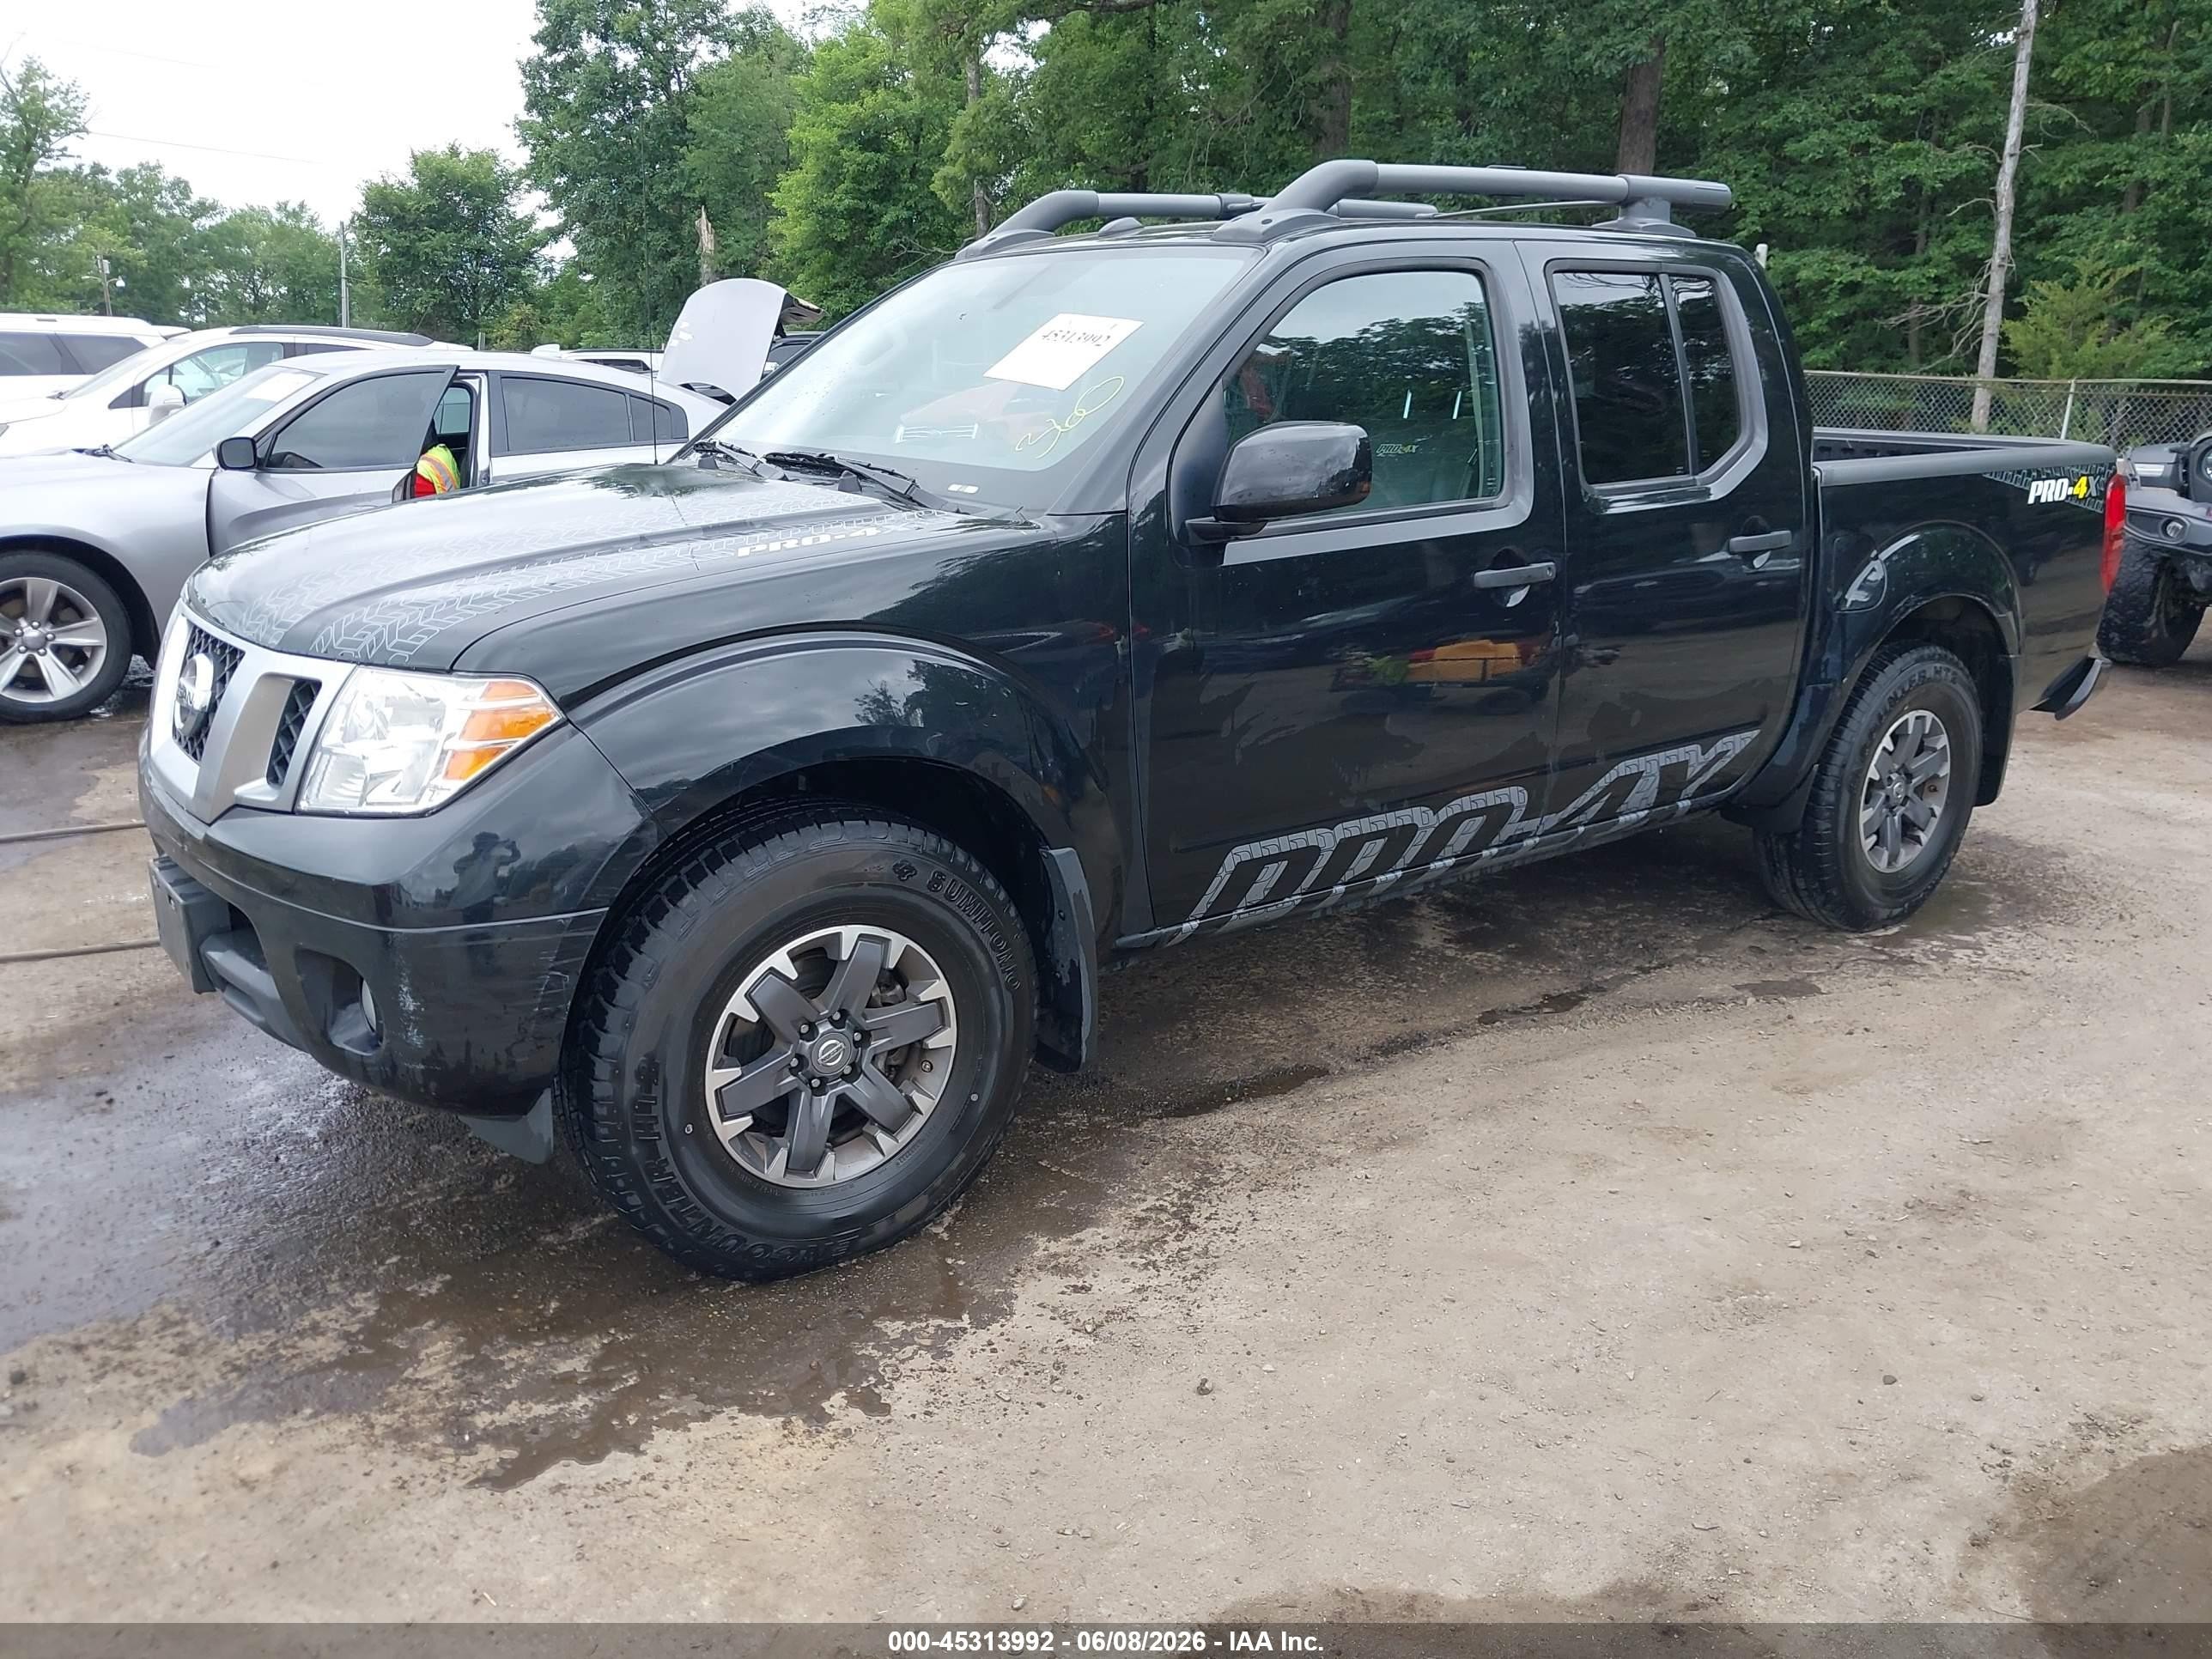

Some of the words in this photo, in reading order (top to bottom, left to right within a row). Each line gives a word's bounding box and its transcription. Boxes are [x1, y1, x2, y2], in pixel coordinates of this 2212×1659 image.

[1042, 329, 1112, 348] 45313992
[2027, 476, 2100, 505] PRO-4X
[927, 869, 1022, 990] SUMITOMO
